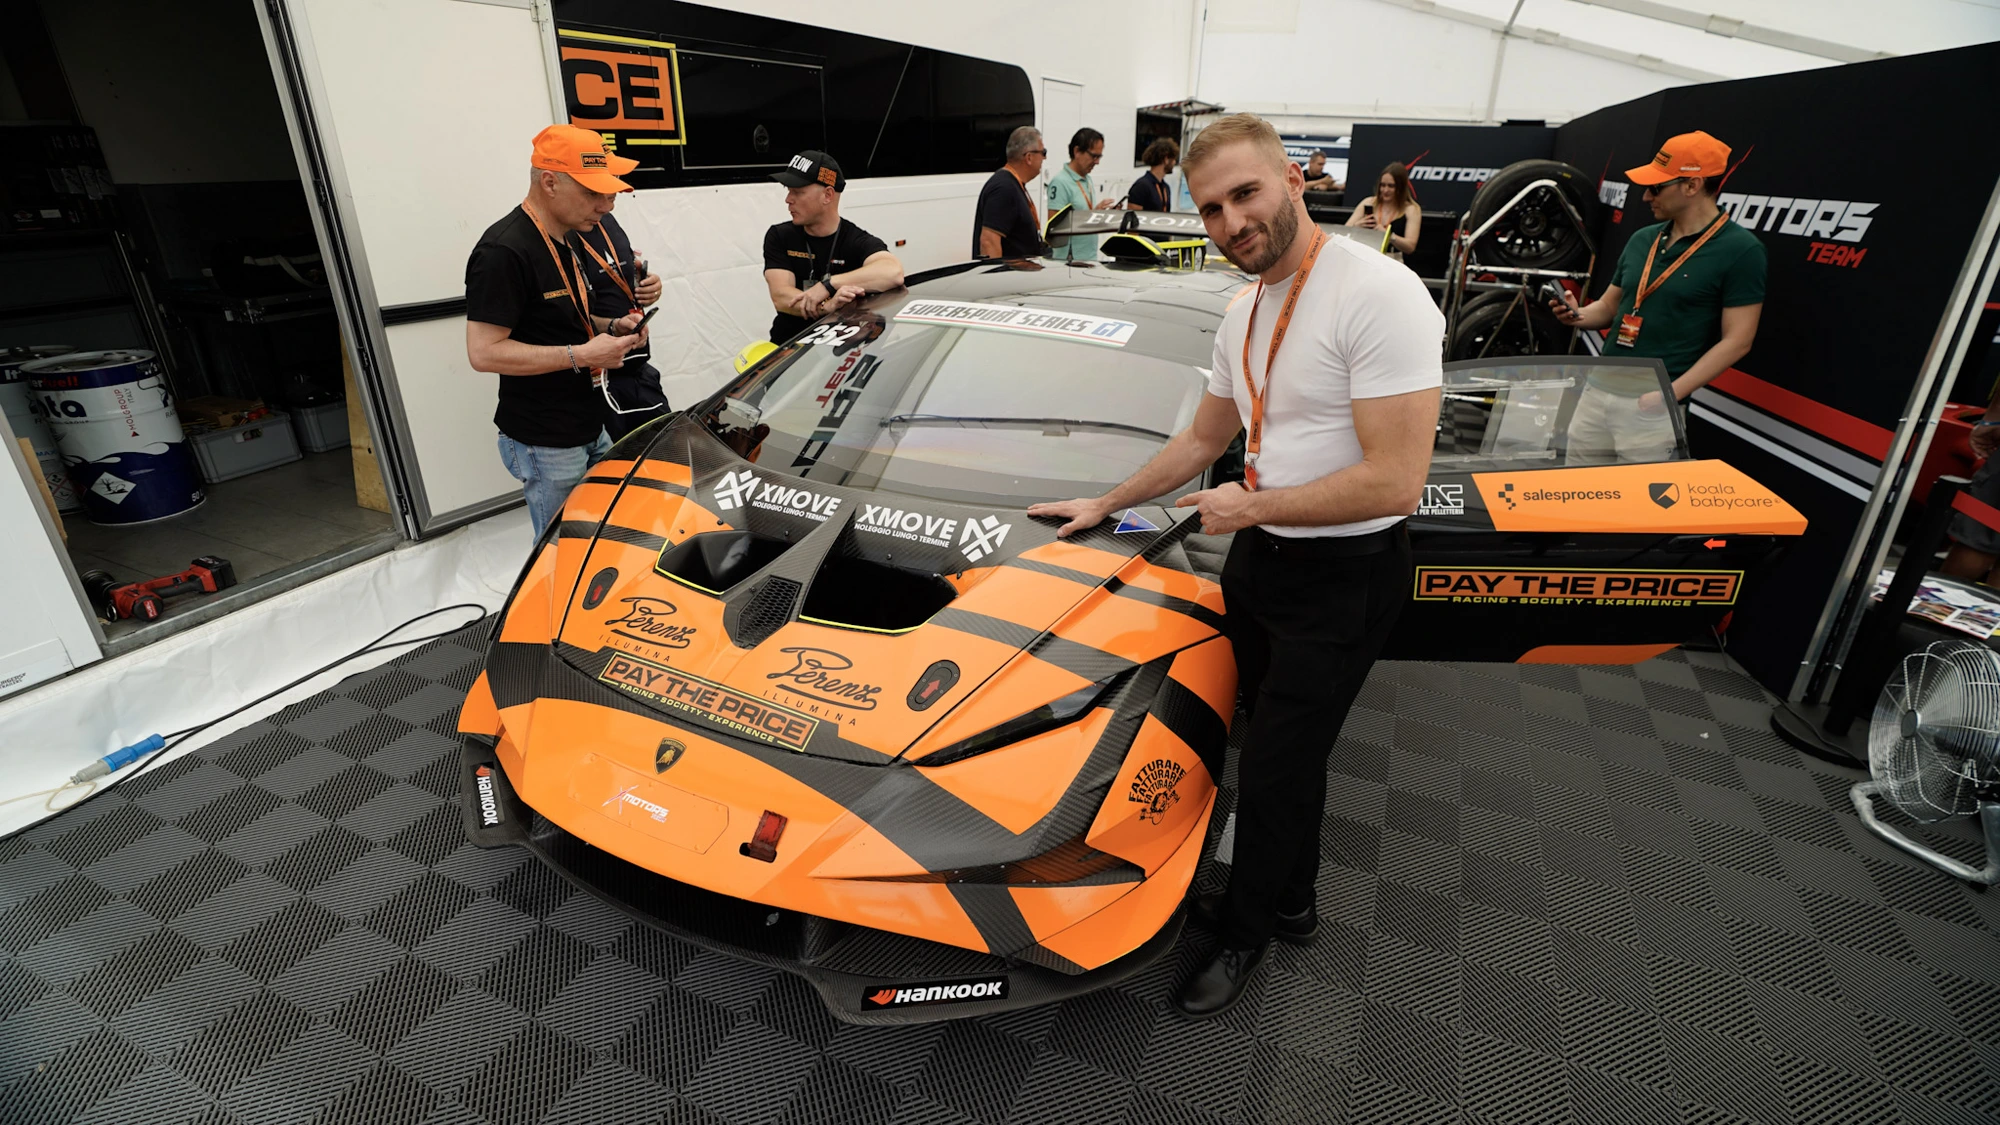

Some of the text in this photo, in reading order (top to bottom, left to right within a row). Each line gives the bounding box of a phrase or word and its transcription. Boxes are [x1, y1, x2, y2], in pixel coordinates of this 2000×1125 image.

[788, 154, 813, 173] FLOW
[1050, 185, 1057, 200] 3
[1806, 241, 1867, 268] TEAM
[902, 303, 1135, 338] SUPERSPORT SERIES GT
[795, 323, 861, 347] 252
[124, 387, 136, 404] ITALY
[755, 483, 842, 516] XMOVE
[1523, 486, 1621, 502] salesprocess
[1687, 483, 1735, 494] koala
[752, 500, 829, 523] NOLEGGIO LUNGO TERMIN
[857, 504, 958, 540] XMOVE
[854, 522, 950, 548] NOLEGGIO LUNGO TERMINE
[1425, 574, 1730, 598] PAY THE PRICE
[1452, 596, 1692, 607] RACING SOCIETY EXPERIENCE
[599, 635, 670, 662] ILLUMINA
[609, 659, 809, 742] PAY THE PRICE
[619, 682, 775, 743] RACING SOCIETY EXPERIENCE
[763, 690, 857, 727] ILLUMINA
[1128, 759, 1186, 802] FATTURARE
